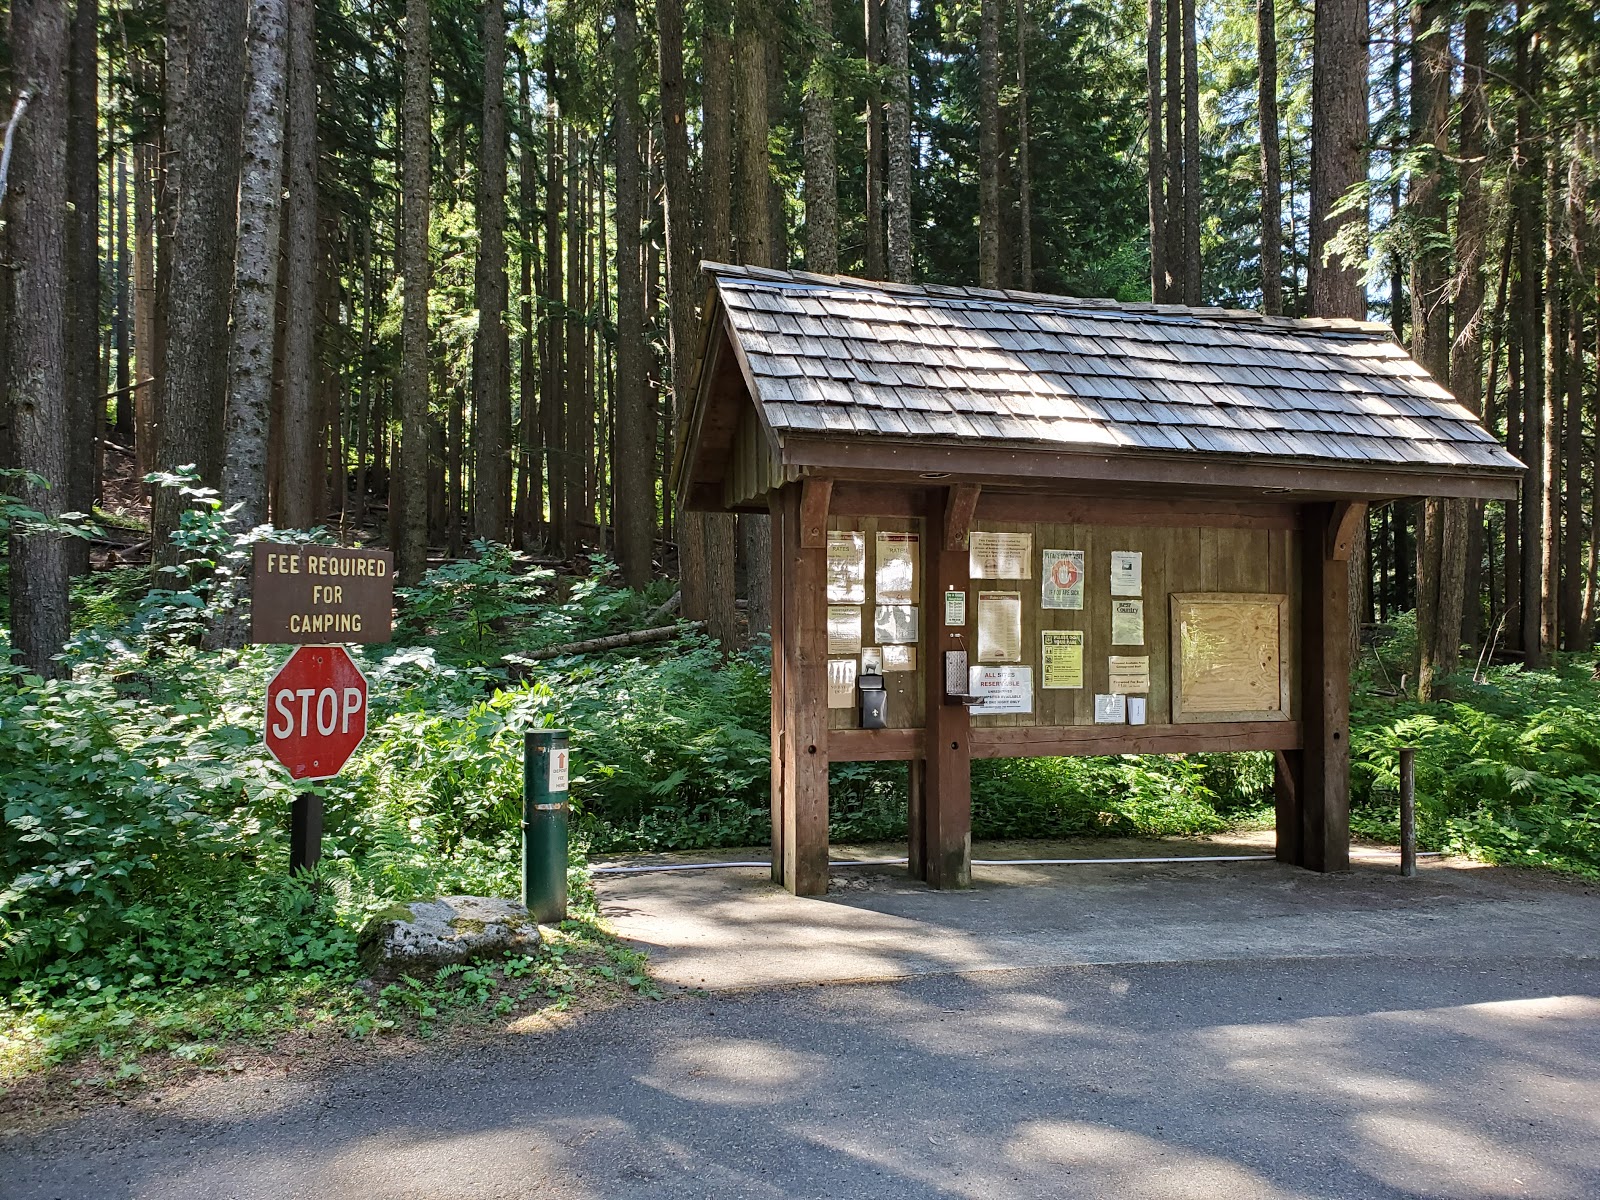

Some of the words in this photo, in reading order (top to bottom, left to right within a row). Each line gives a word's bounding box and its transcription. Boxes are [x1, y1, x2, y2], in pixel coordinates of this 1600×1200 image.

[268, 554, 300, 574] FEE
[308, 555, 386, 577] REQUIRED
[313, 585, 343, 605] FOR
[1116, 607, 1139, 615] Country
[290, 613, 361, 633] CAMPING
[272, 687, 363, 739] STOP
